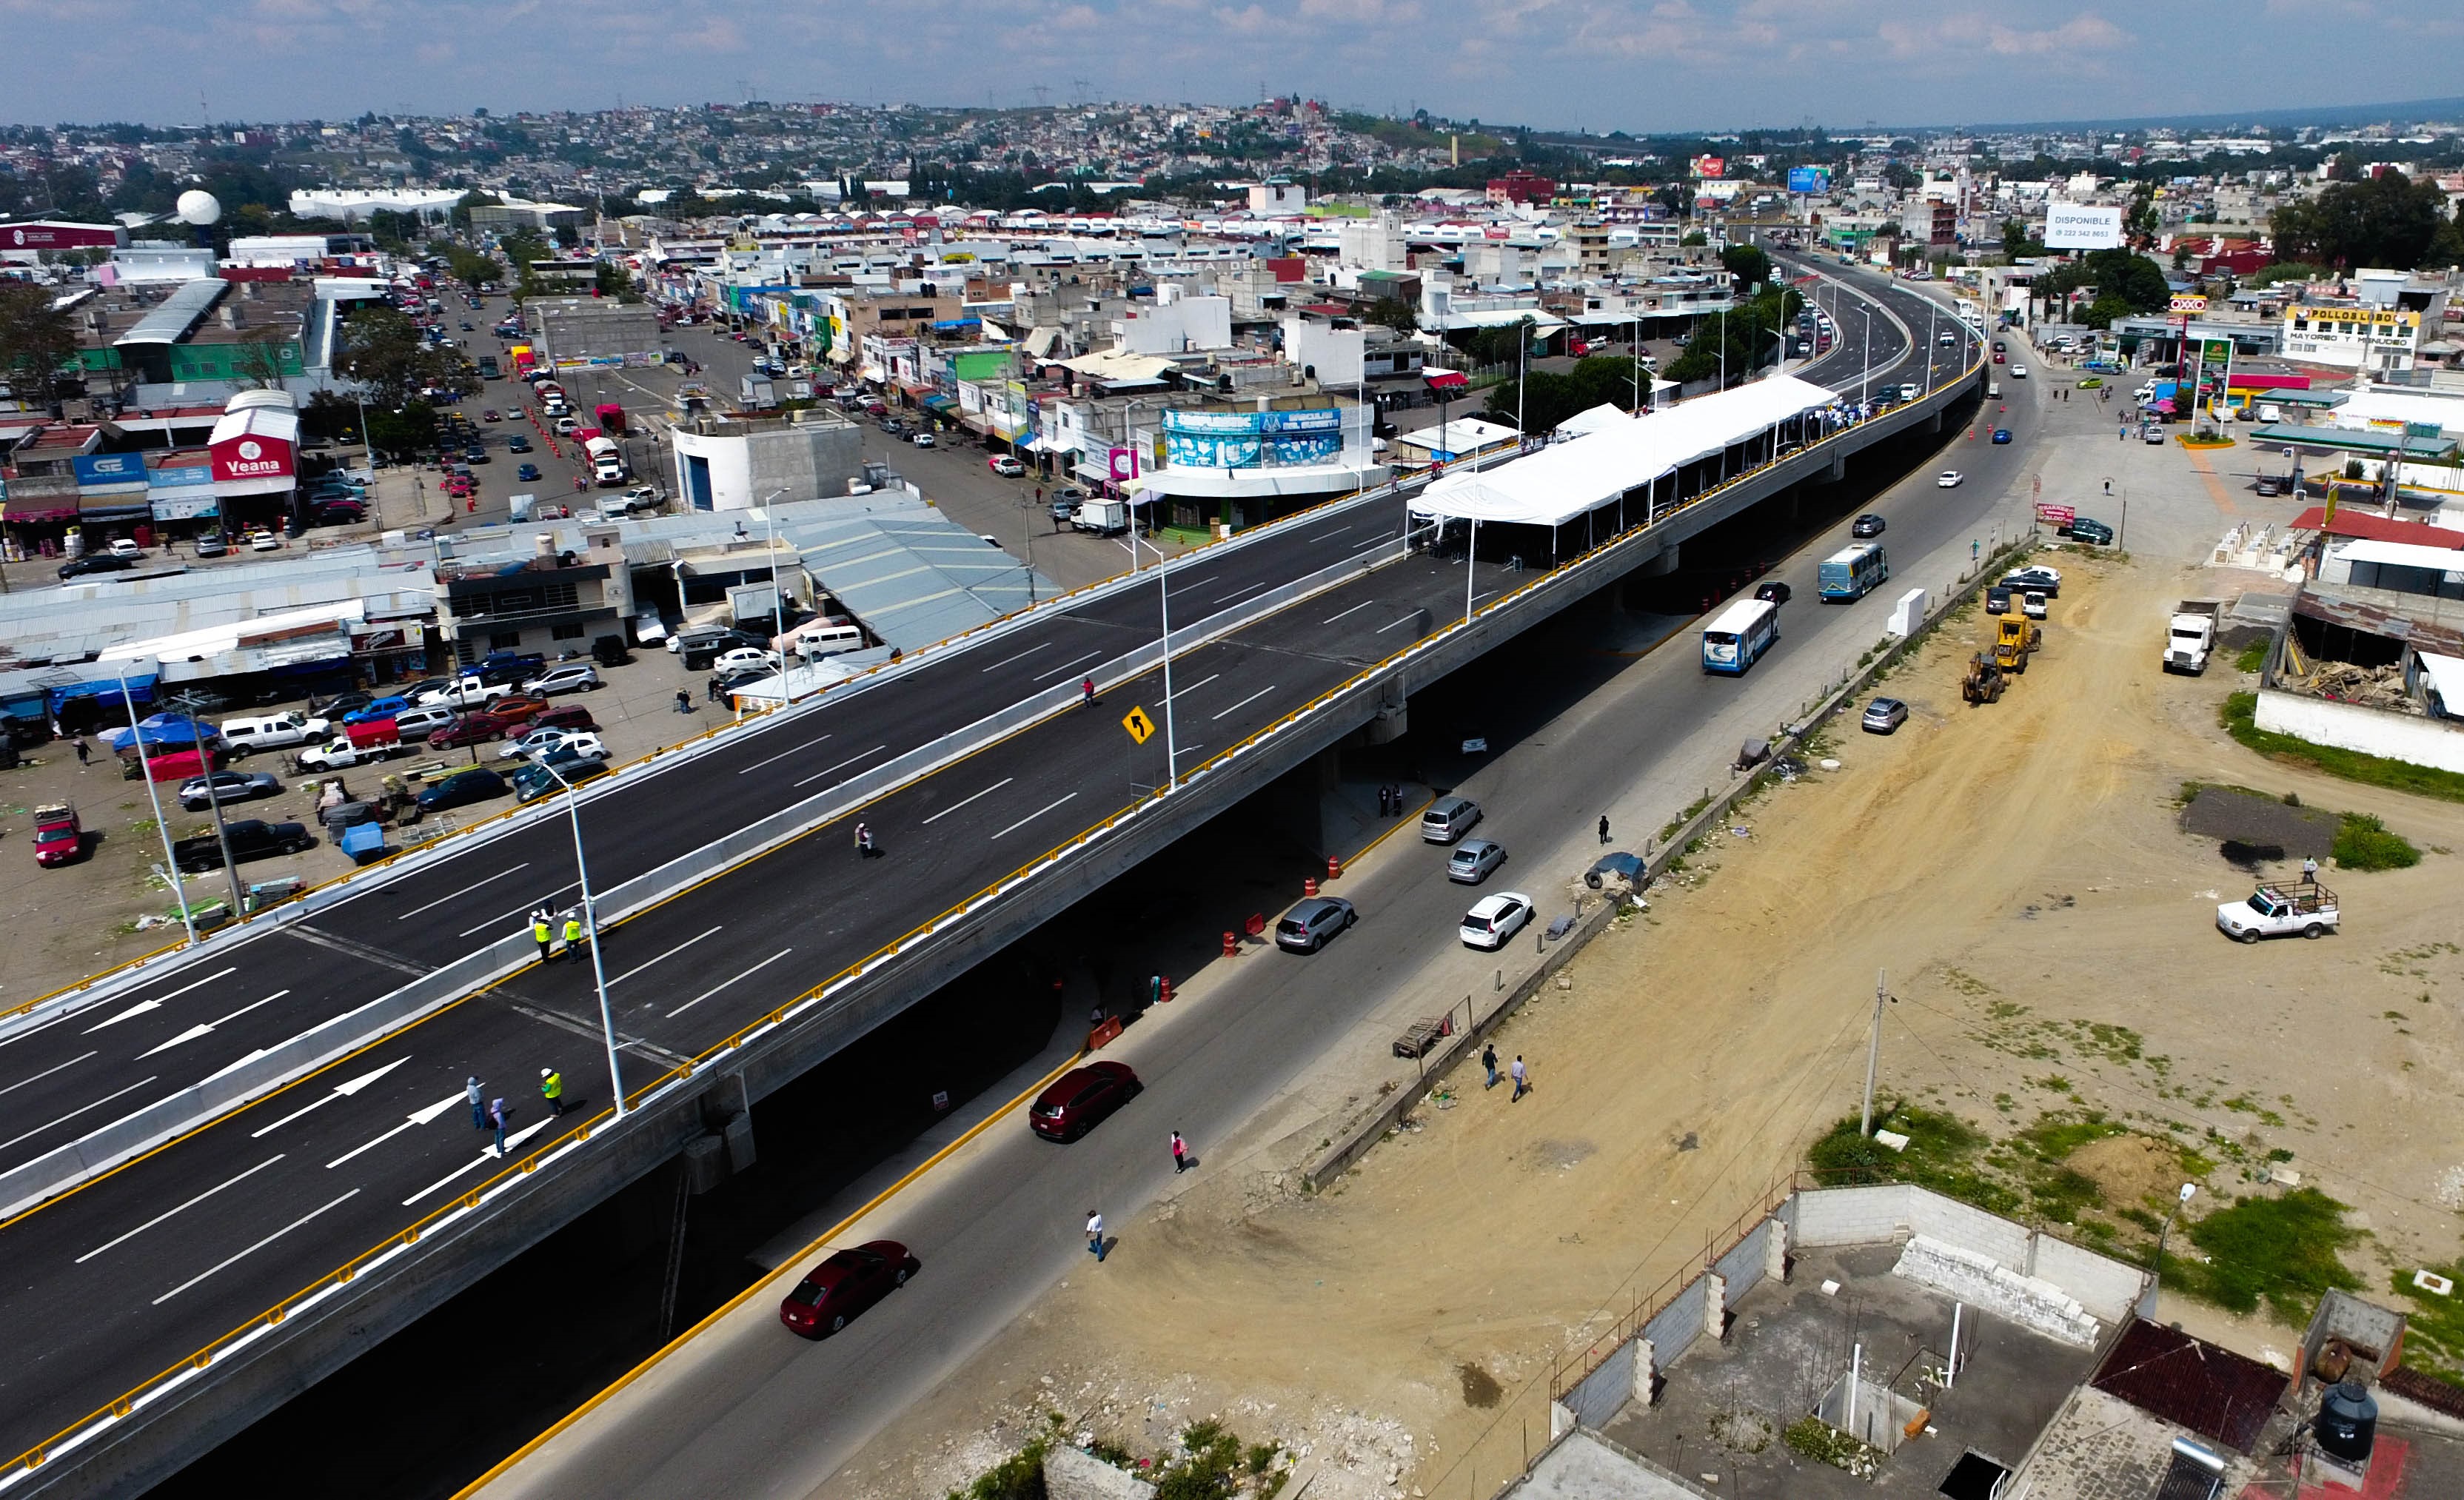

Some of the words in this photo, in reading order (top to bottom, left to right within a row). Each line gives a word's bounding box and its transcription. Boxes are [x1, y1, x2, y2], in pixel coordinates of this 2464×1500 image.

[2055, 216, 2111, 225] DISPONIBLE
[2170, 298, 2205, 309] OXXO
[2311, 309, 2357, 320] POLLOS
[2290, 332, 2337, 341] MAYOREO
[2357, 337, 2407, 346] MENUDEO
[225, 460, 281, 473] Veana
[1999, 646, 2011, 655] CAT
